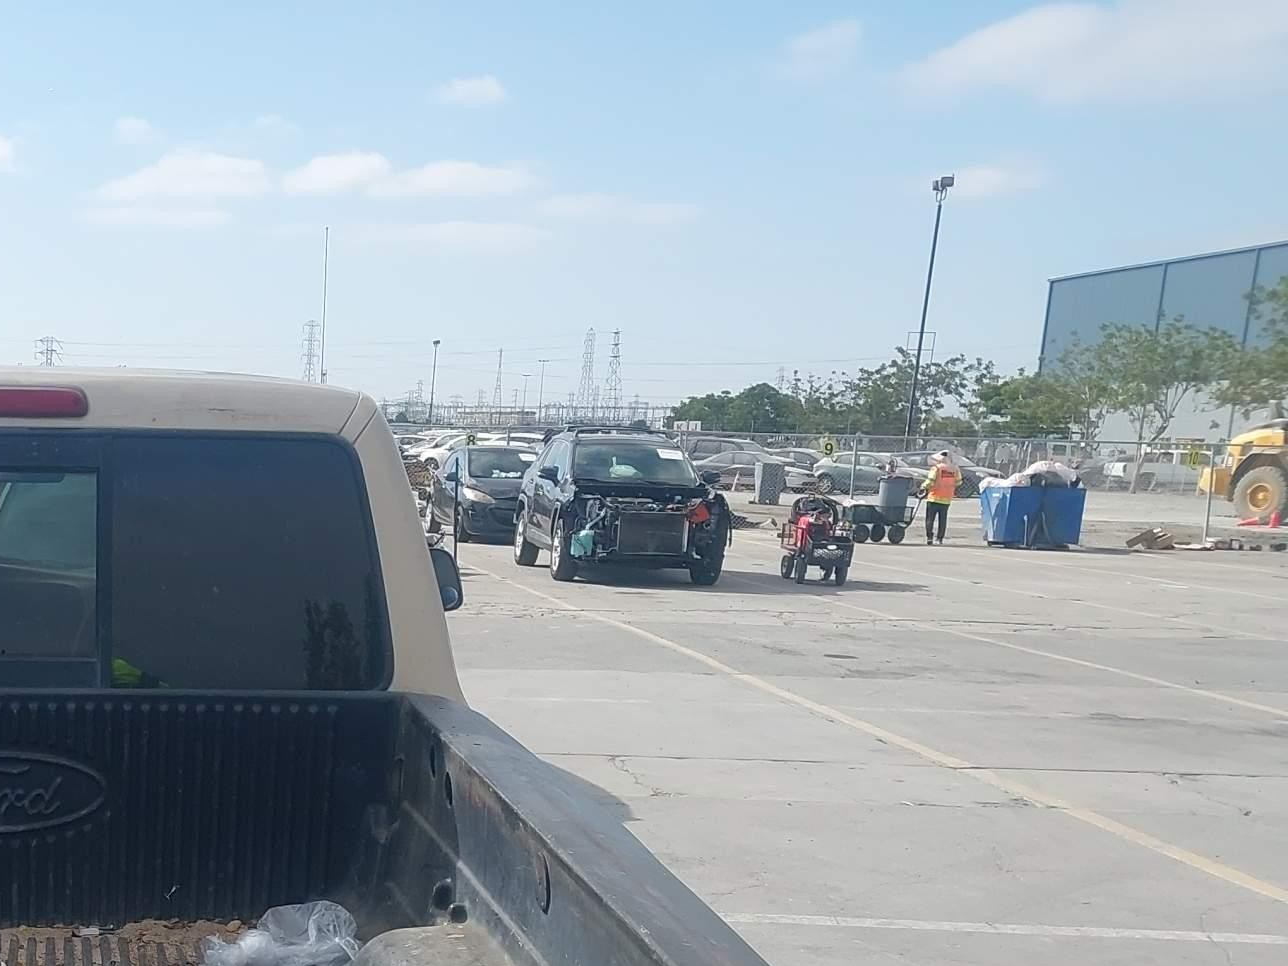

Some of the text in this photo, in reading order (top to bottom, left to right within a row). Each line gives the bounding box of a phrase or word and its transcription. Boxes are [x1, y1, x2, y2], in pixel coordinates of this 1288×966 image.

[467, 434, 476, 446] 8
[824, 442, 833, 455] 9
[1188, 451, 1199, 465] 10
